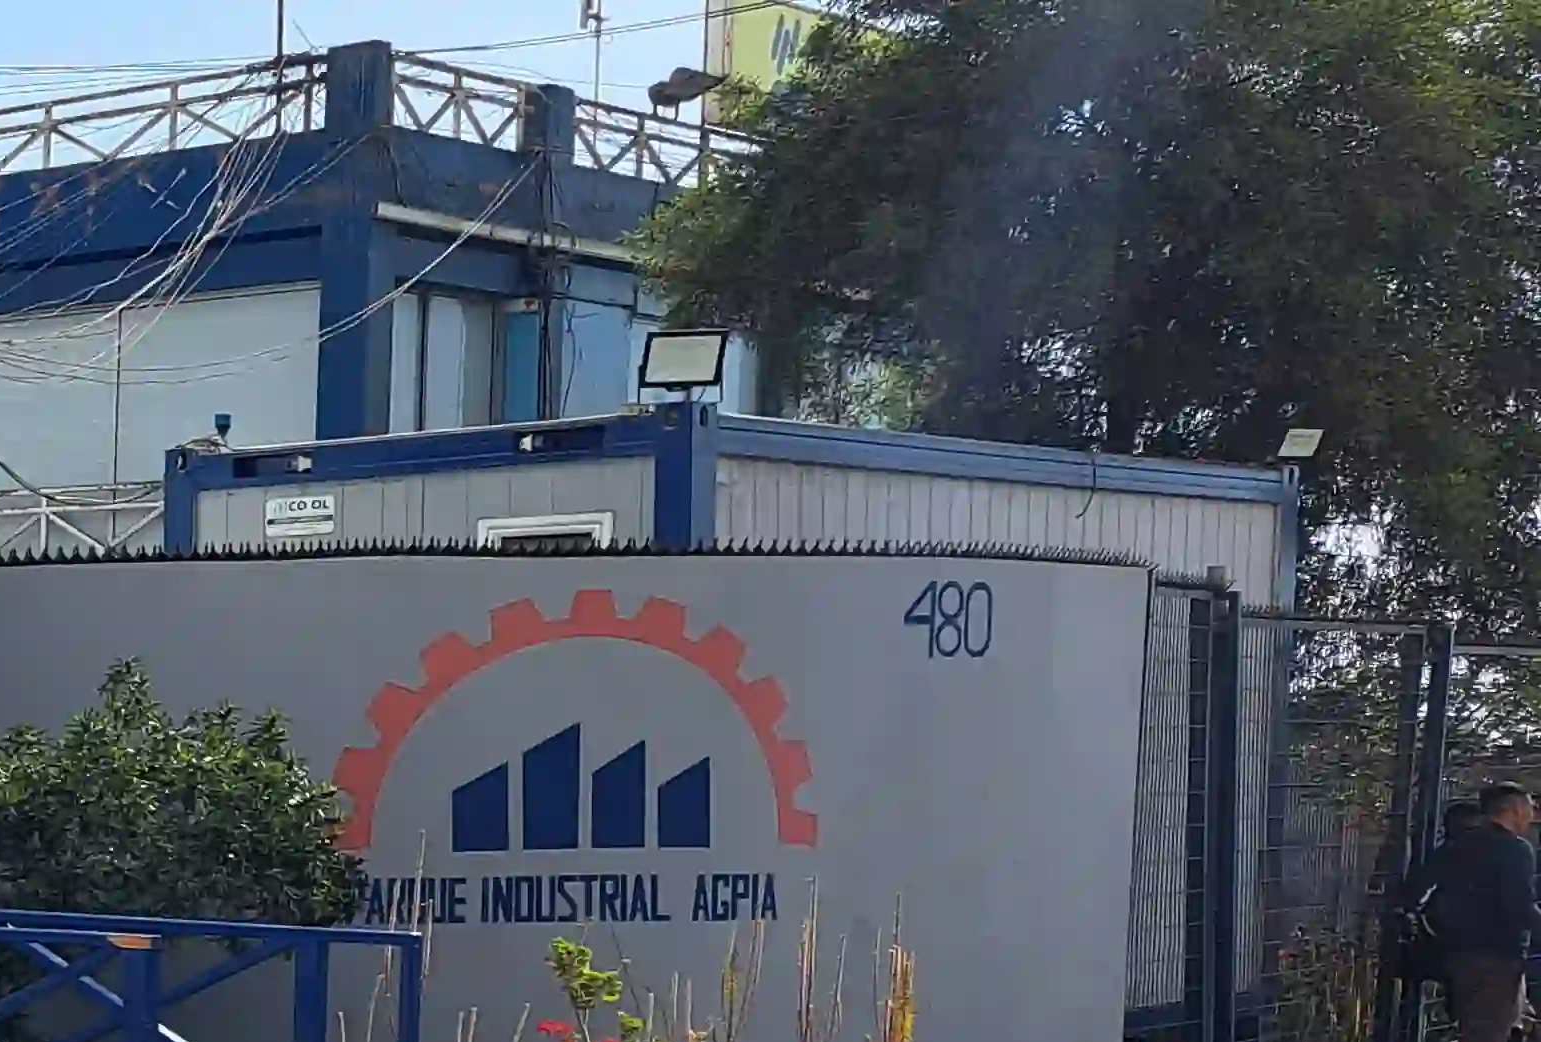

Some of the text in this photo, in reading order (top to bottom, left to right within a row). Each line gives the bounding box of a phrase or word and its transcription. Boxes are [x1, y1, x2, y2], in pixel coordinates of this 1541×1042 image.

[903, 580, 993, 658] 480
[363, 873, 777, 924] ARQUE INDUSTRIAL AGPIA
